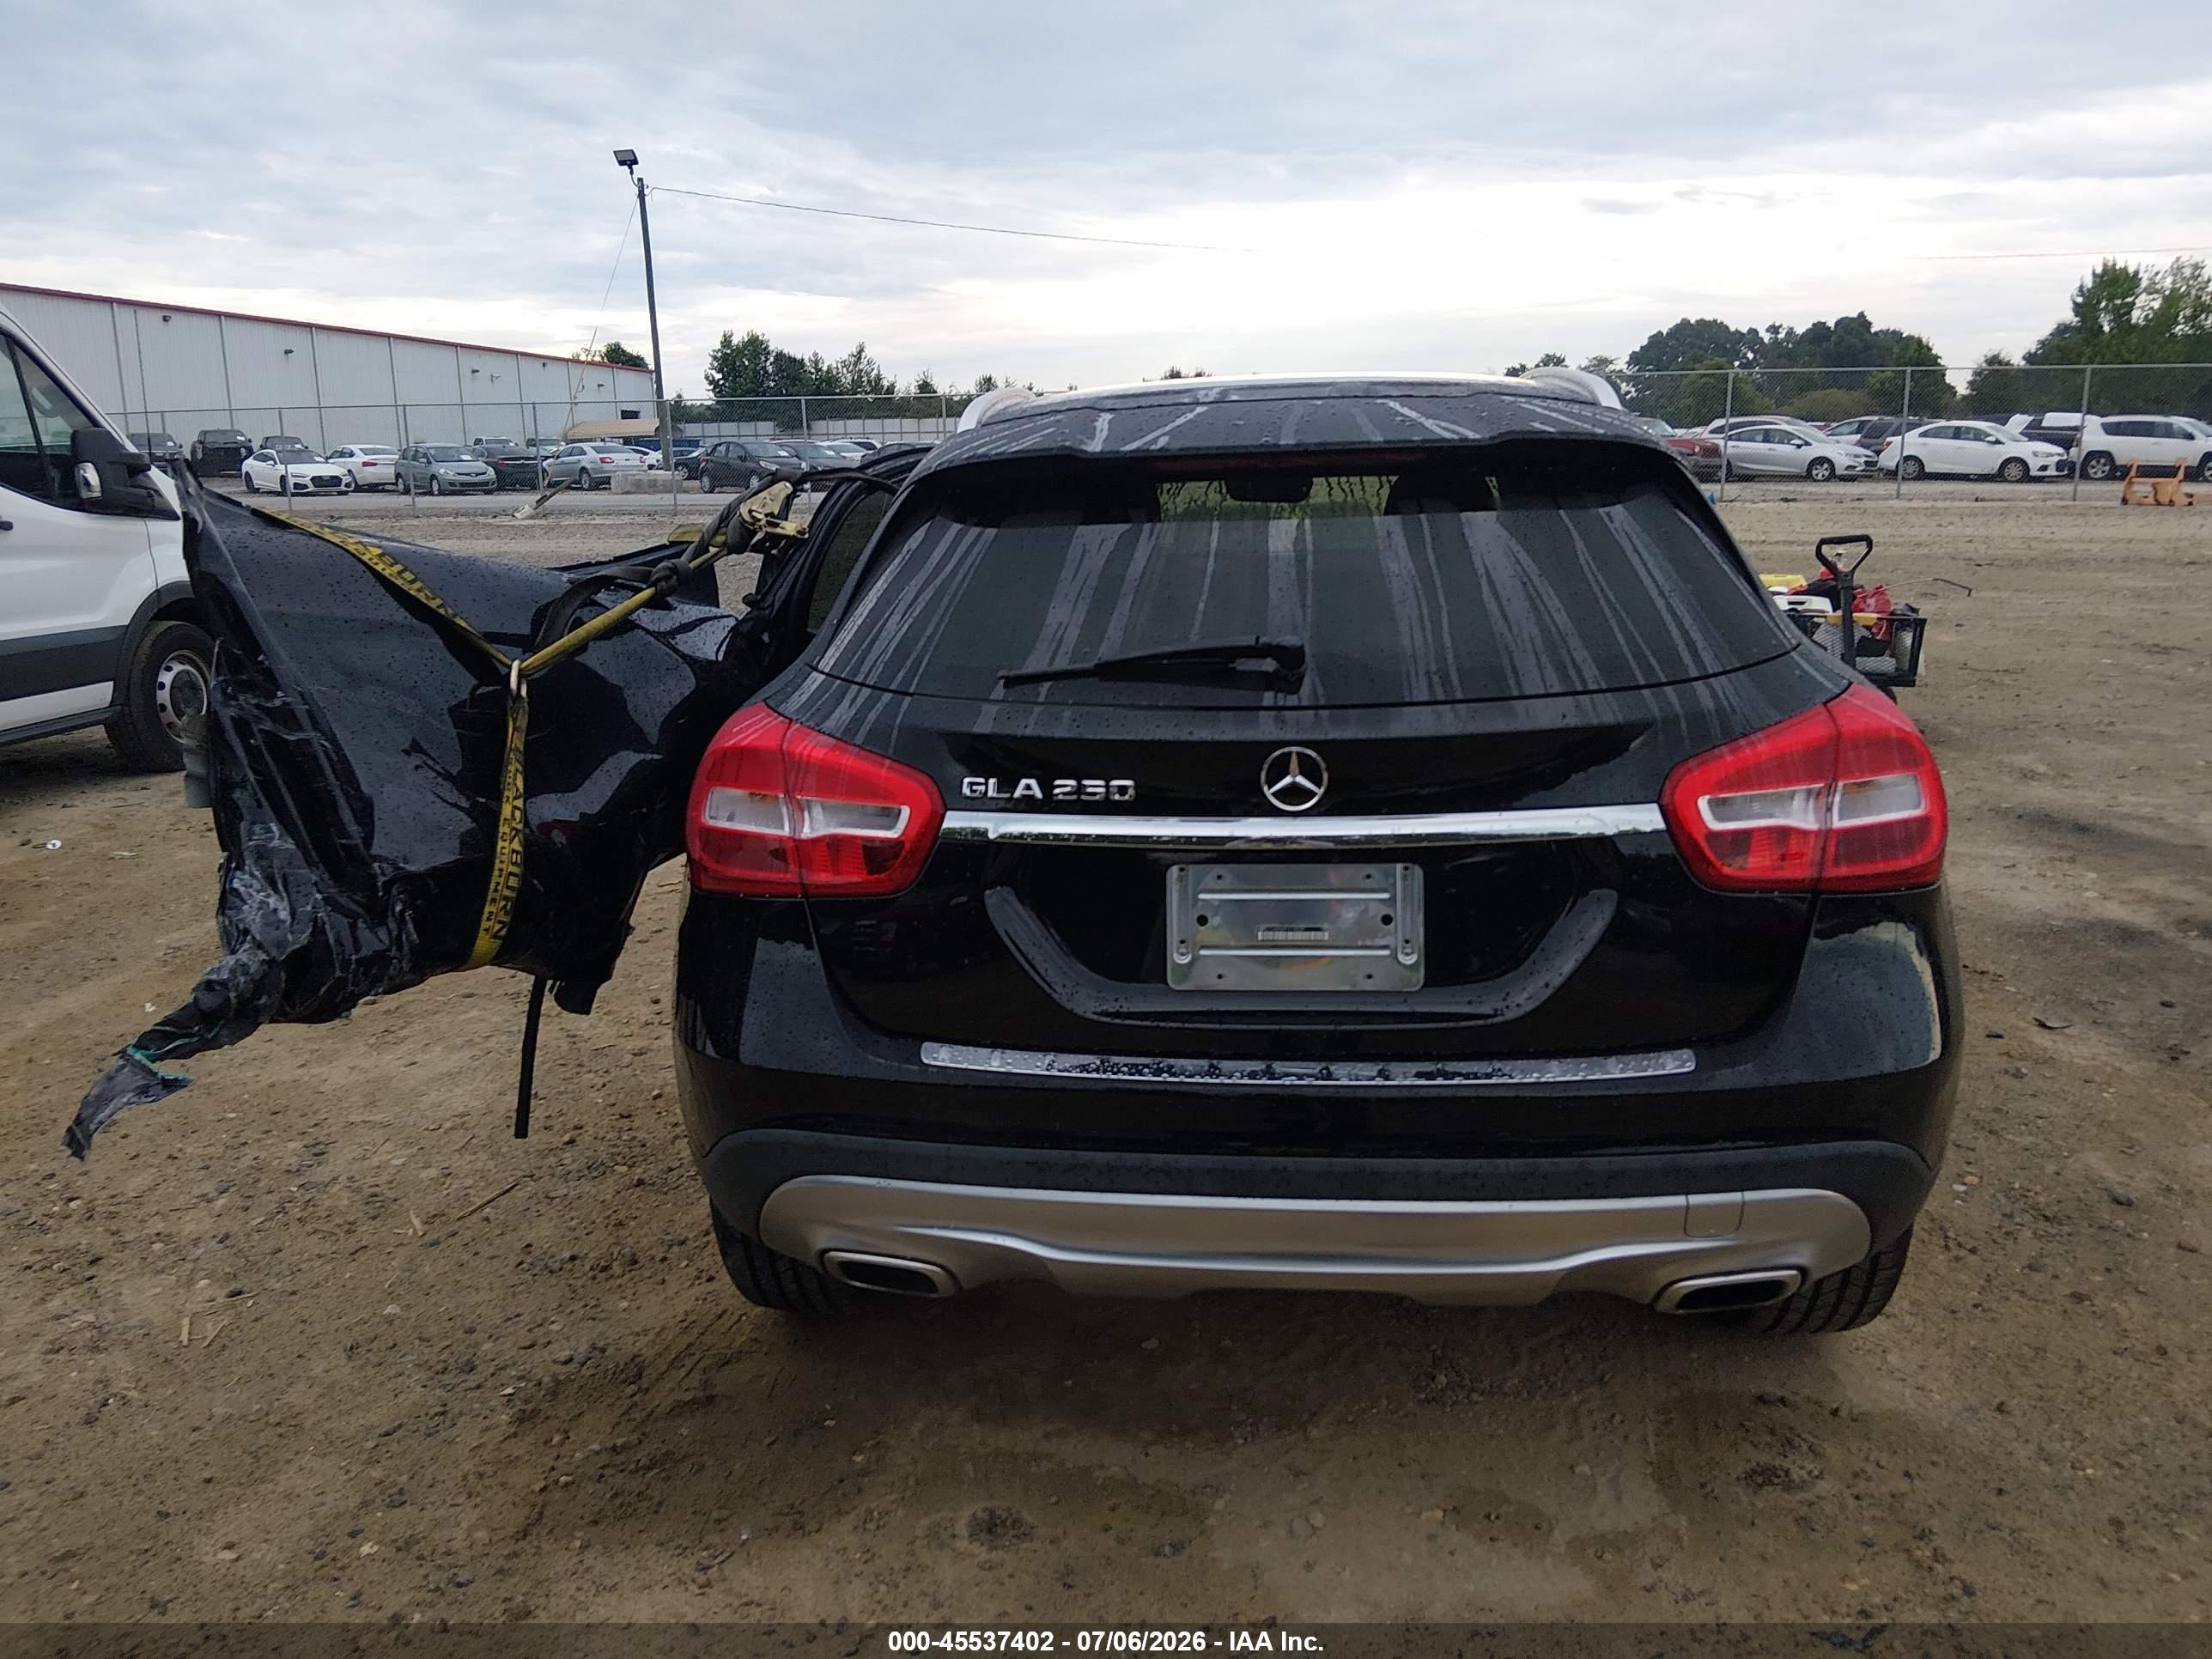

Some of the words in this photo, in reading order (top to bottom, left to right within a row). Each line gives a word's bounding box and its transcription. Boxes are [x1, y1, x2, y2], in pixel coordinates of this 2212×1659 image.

[961, 776, 1044, 799] GLA
[1052, 779, 1136, 800] 230
[483, 816, 510, 936] EQUIPMENT
